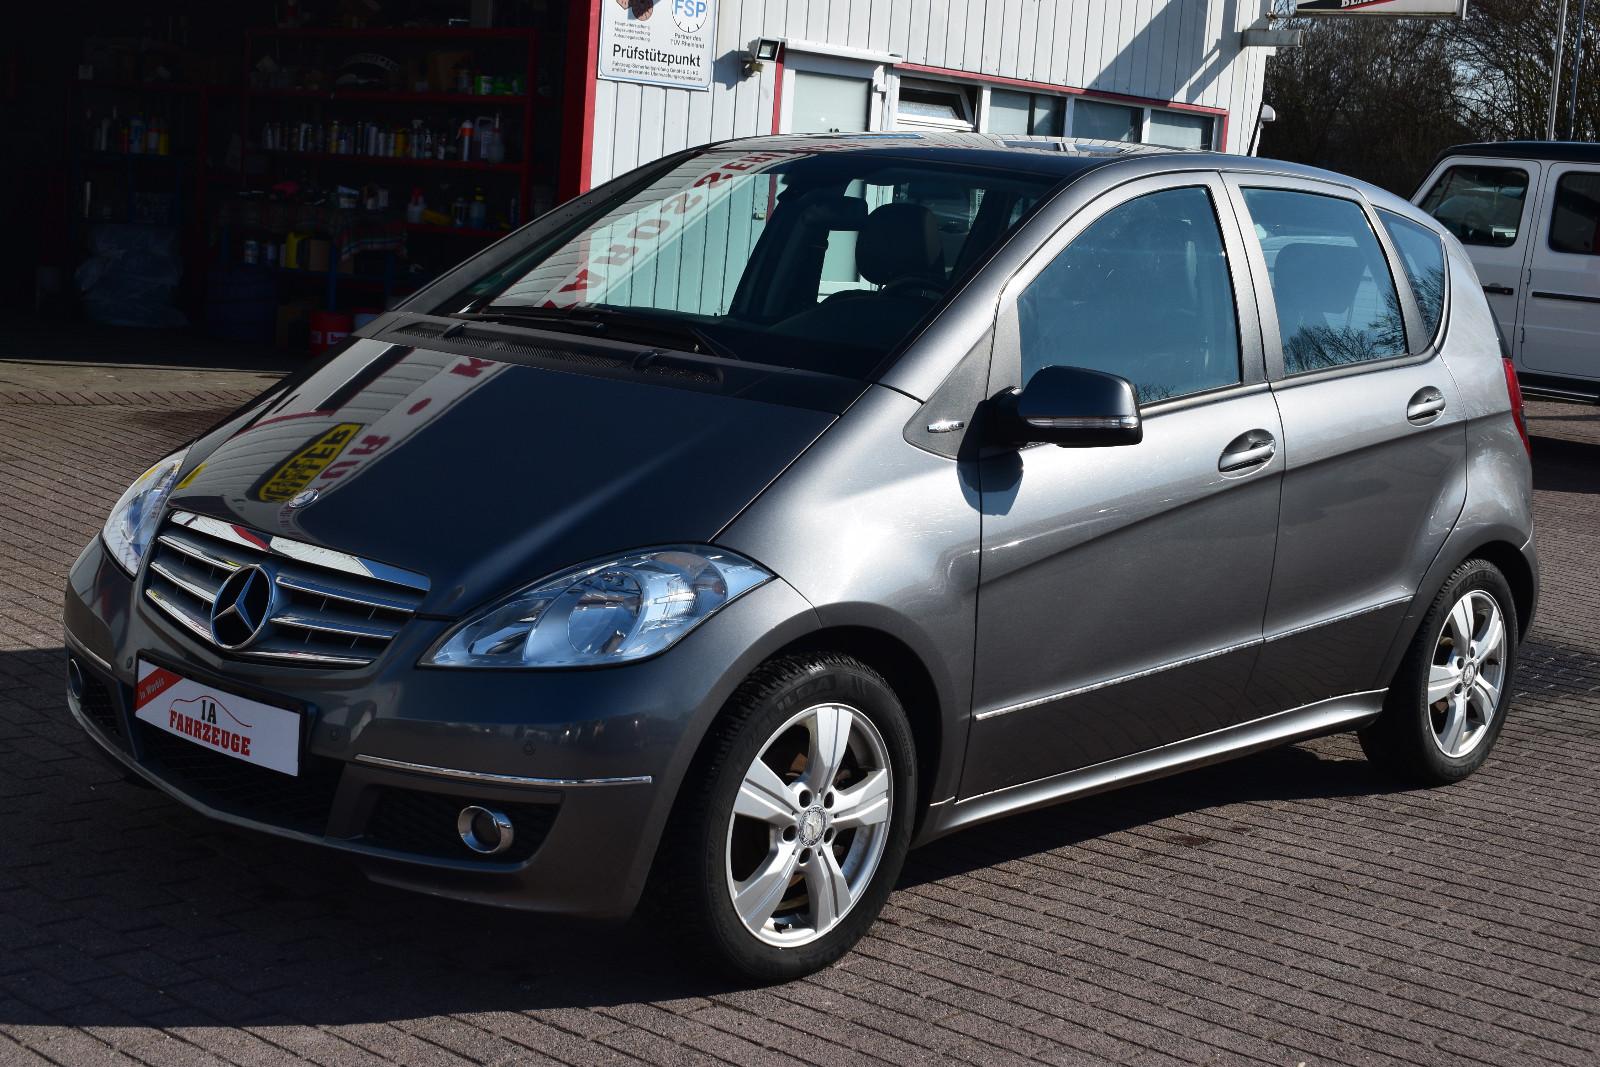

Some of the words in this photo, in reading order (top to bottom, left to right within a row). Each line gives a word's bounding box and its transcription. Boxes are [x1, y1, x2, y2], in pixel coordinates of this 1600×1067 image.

[674, 0, 707, 18] FSP
[612, 43, 701, 68] Prüfstützpunkt
[201, 700, 217, 724] 1A
[169, 710, 251, 756] FAHRZEUGE
